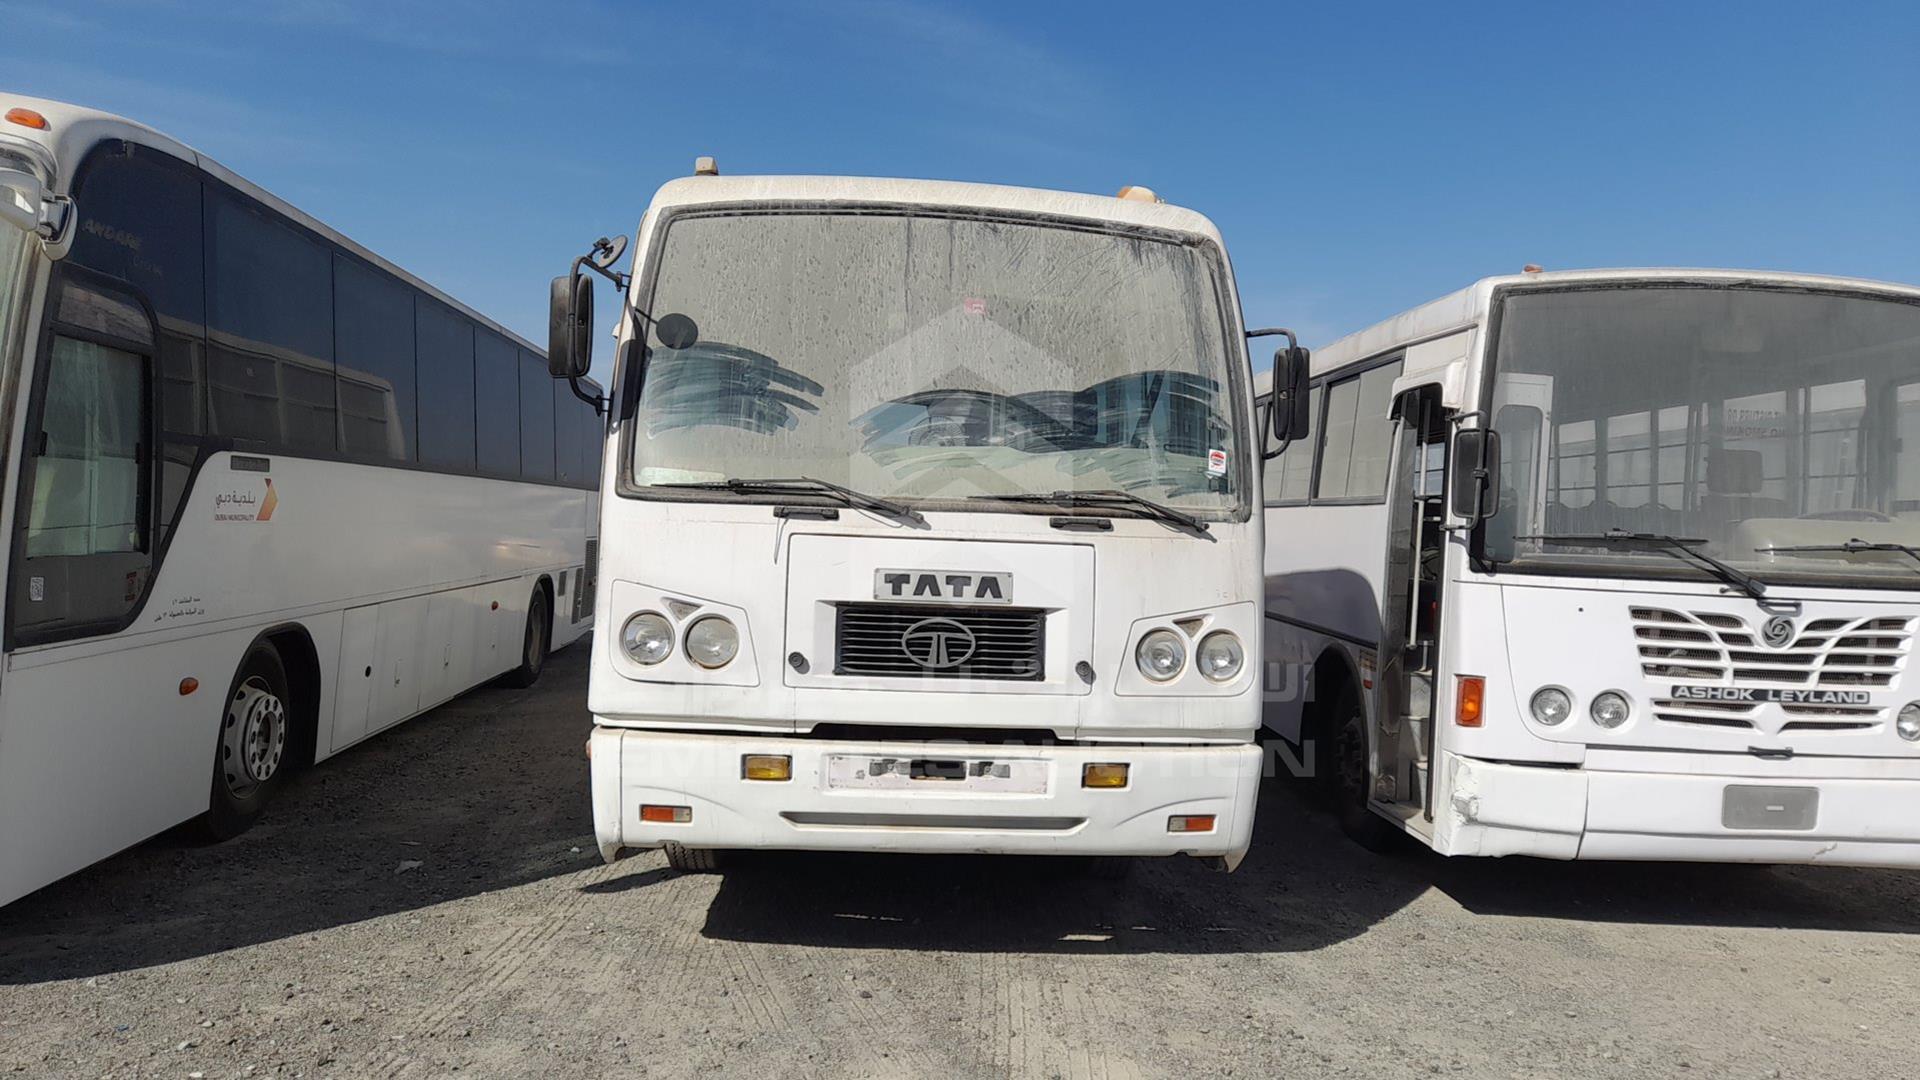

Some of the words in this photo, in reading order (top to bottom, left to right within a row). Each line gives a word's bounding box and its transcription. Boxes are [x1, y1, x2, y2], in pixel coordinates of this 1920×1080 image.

[884, 573, 1003, 599] TATA
[1674, 685, 1754, 701] ASHOK
[1767, 689, 1869, 704] LEYLAND
